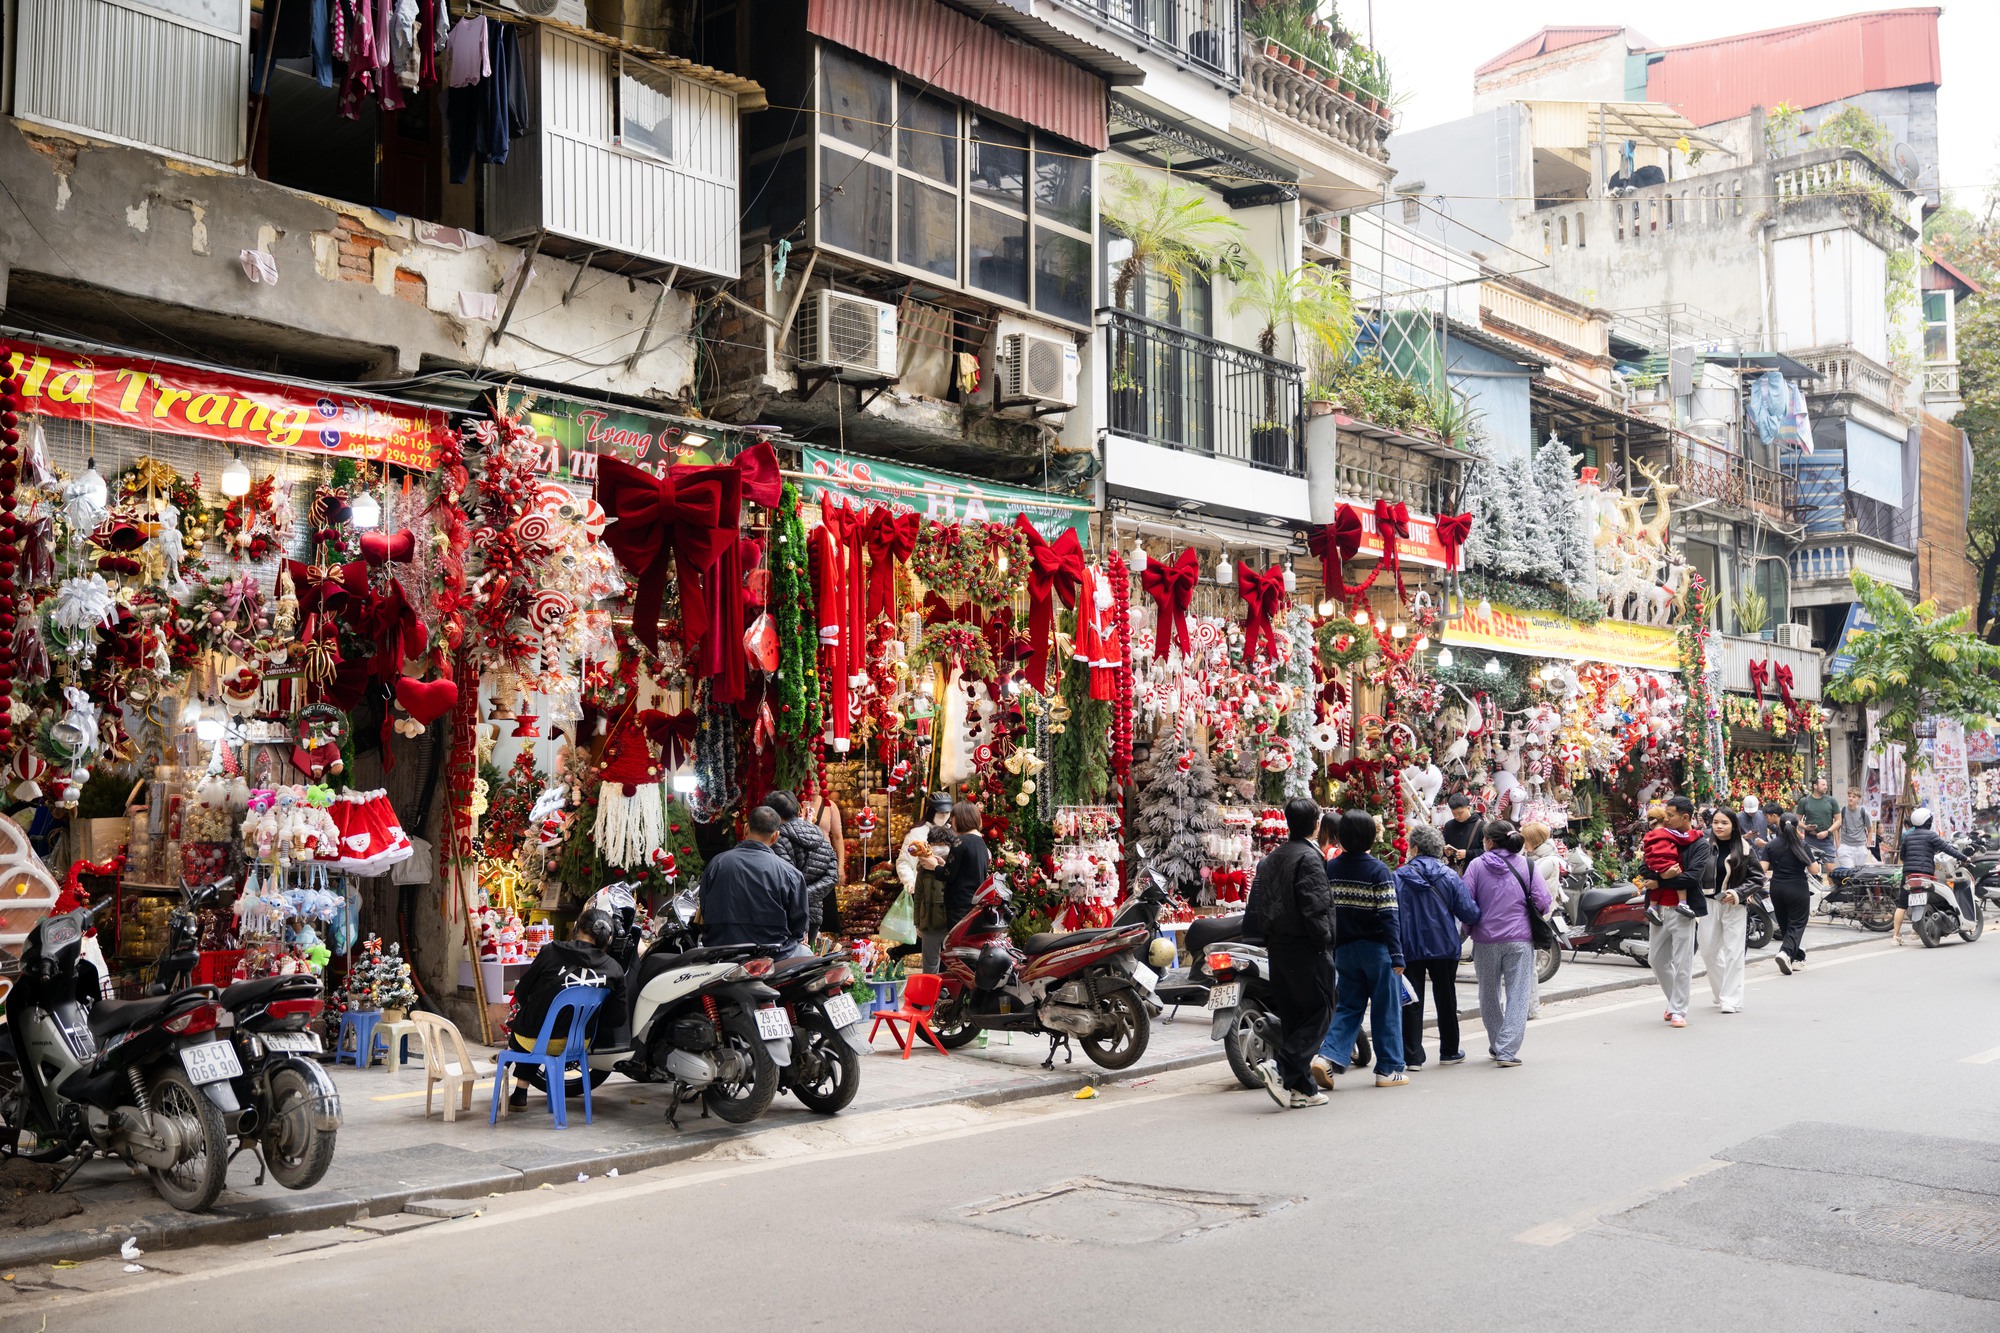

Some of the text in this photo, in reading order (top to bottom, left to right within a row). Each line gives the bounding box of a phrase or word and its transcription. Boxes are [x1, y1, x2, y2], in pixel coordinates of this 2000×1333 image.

[0, 351, 311, 447] Hà Trang
[341, 398, 377, 426] 50
[348, 427, 433, 452] 0912 430 169
[576, 410, 654, 459] Trang
[348, 442, 433, 468] 0989 296 972
[830, 458, 873, 493] 48
[862, 497, 889, 512] 372
[889, 501, 915, 515] 499
[922, 481, 991, 526] HÀ
[1448, 602, 1491, 636] LINH
[265, 666, 297, 677] CHRISTMAS
[303, 704, 336, 717] WELCOME
[692, 970, 712, 980] mode
[1213, 985, 1236, 998] 29-C1
[828, 996, 852, 1014] 29-E2
[1210, 995, 1237, 1009] 754.75
[760, 1010, 784, 1025] 29-C1
[832, 1007, 860, 1027] 318.69
[760, 1023, 791, 1038] 786.78
[189, 1045, 228, 1065] 29-C1
[190, 1060, 238, 1082] 068.90
